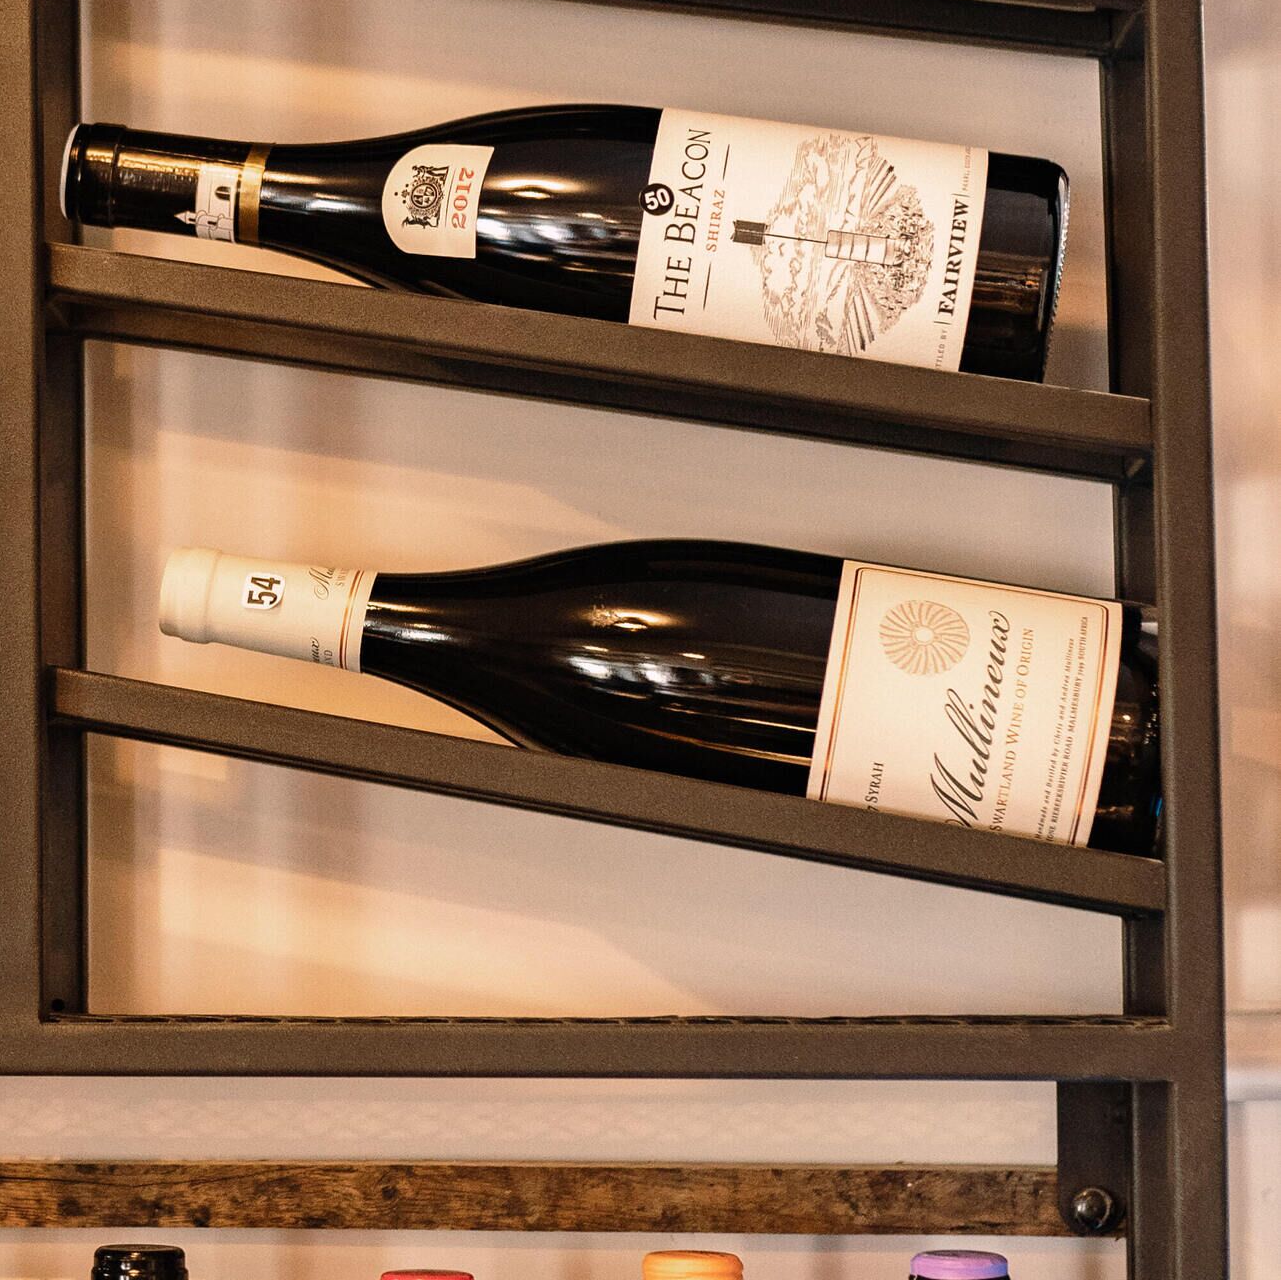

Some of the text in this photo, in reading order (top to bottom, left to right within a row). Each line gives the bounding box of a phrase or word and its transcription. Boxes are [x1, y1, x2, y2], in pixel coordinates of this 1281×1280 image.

[453, 167, 475, 230] 2017
[645, 189, 670, 210] 50
[653, 128, 712, 320] THE BEACON
[706, 189, 726, 253] SHIRAZ
[938, 199, 970, 317] FAIRVIEW
[247, 577, 281, 605] 54
[1078, 637, 1087, 660] SOUTH
[930, 611, 1010, 828] Mullineux
[990, 628, 1034, 832] SWARTLAND WINE OF ORIGIN
[1068, 677, 1083, 732] MALMESBURY
[1065, 737, 1074, 759] ROAD
[865, 762, 884, 804] SYRAH
